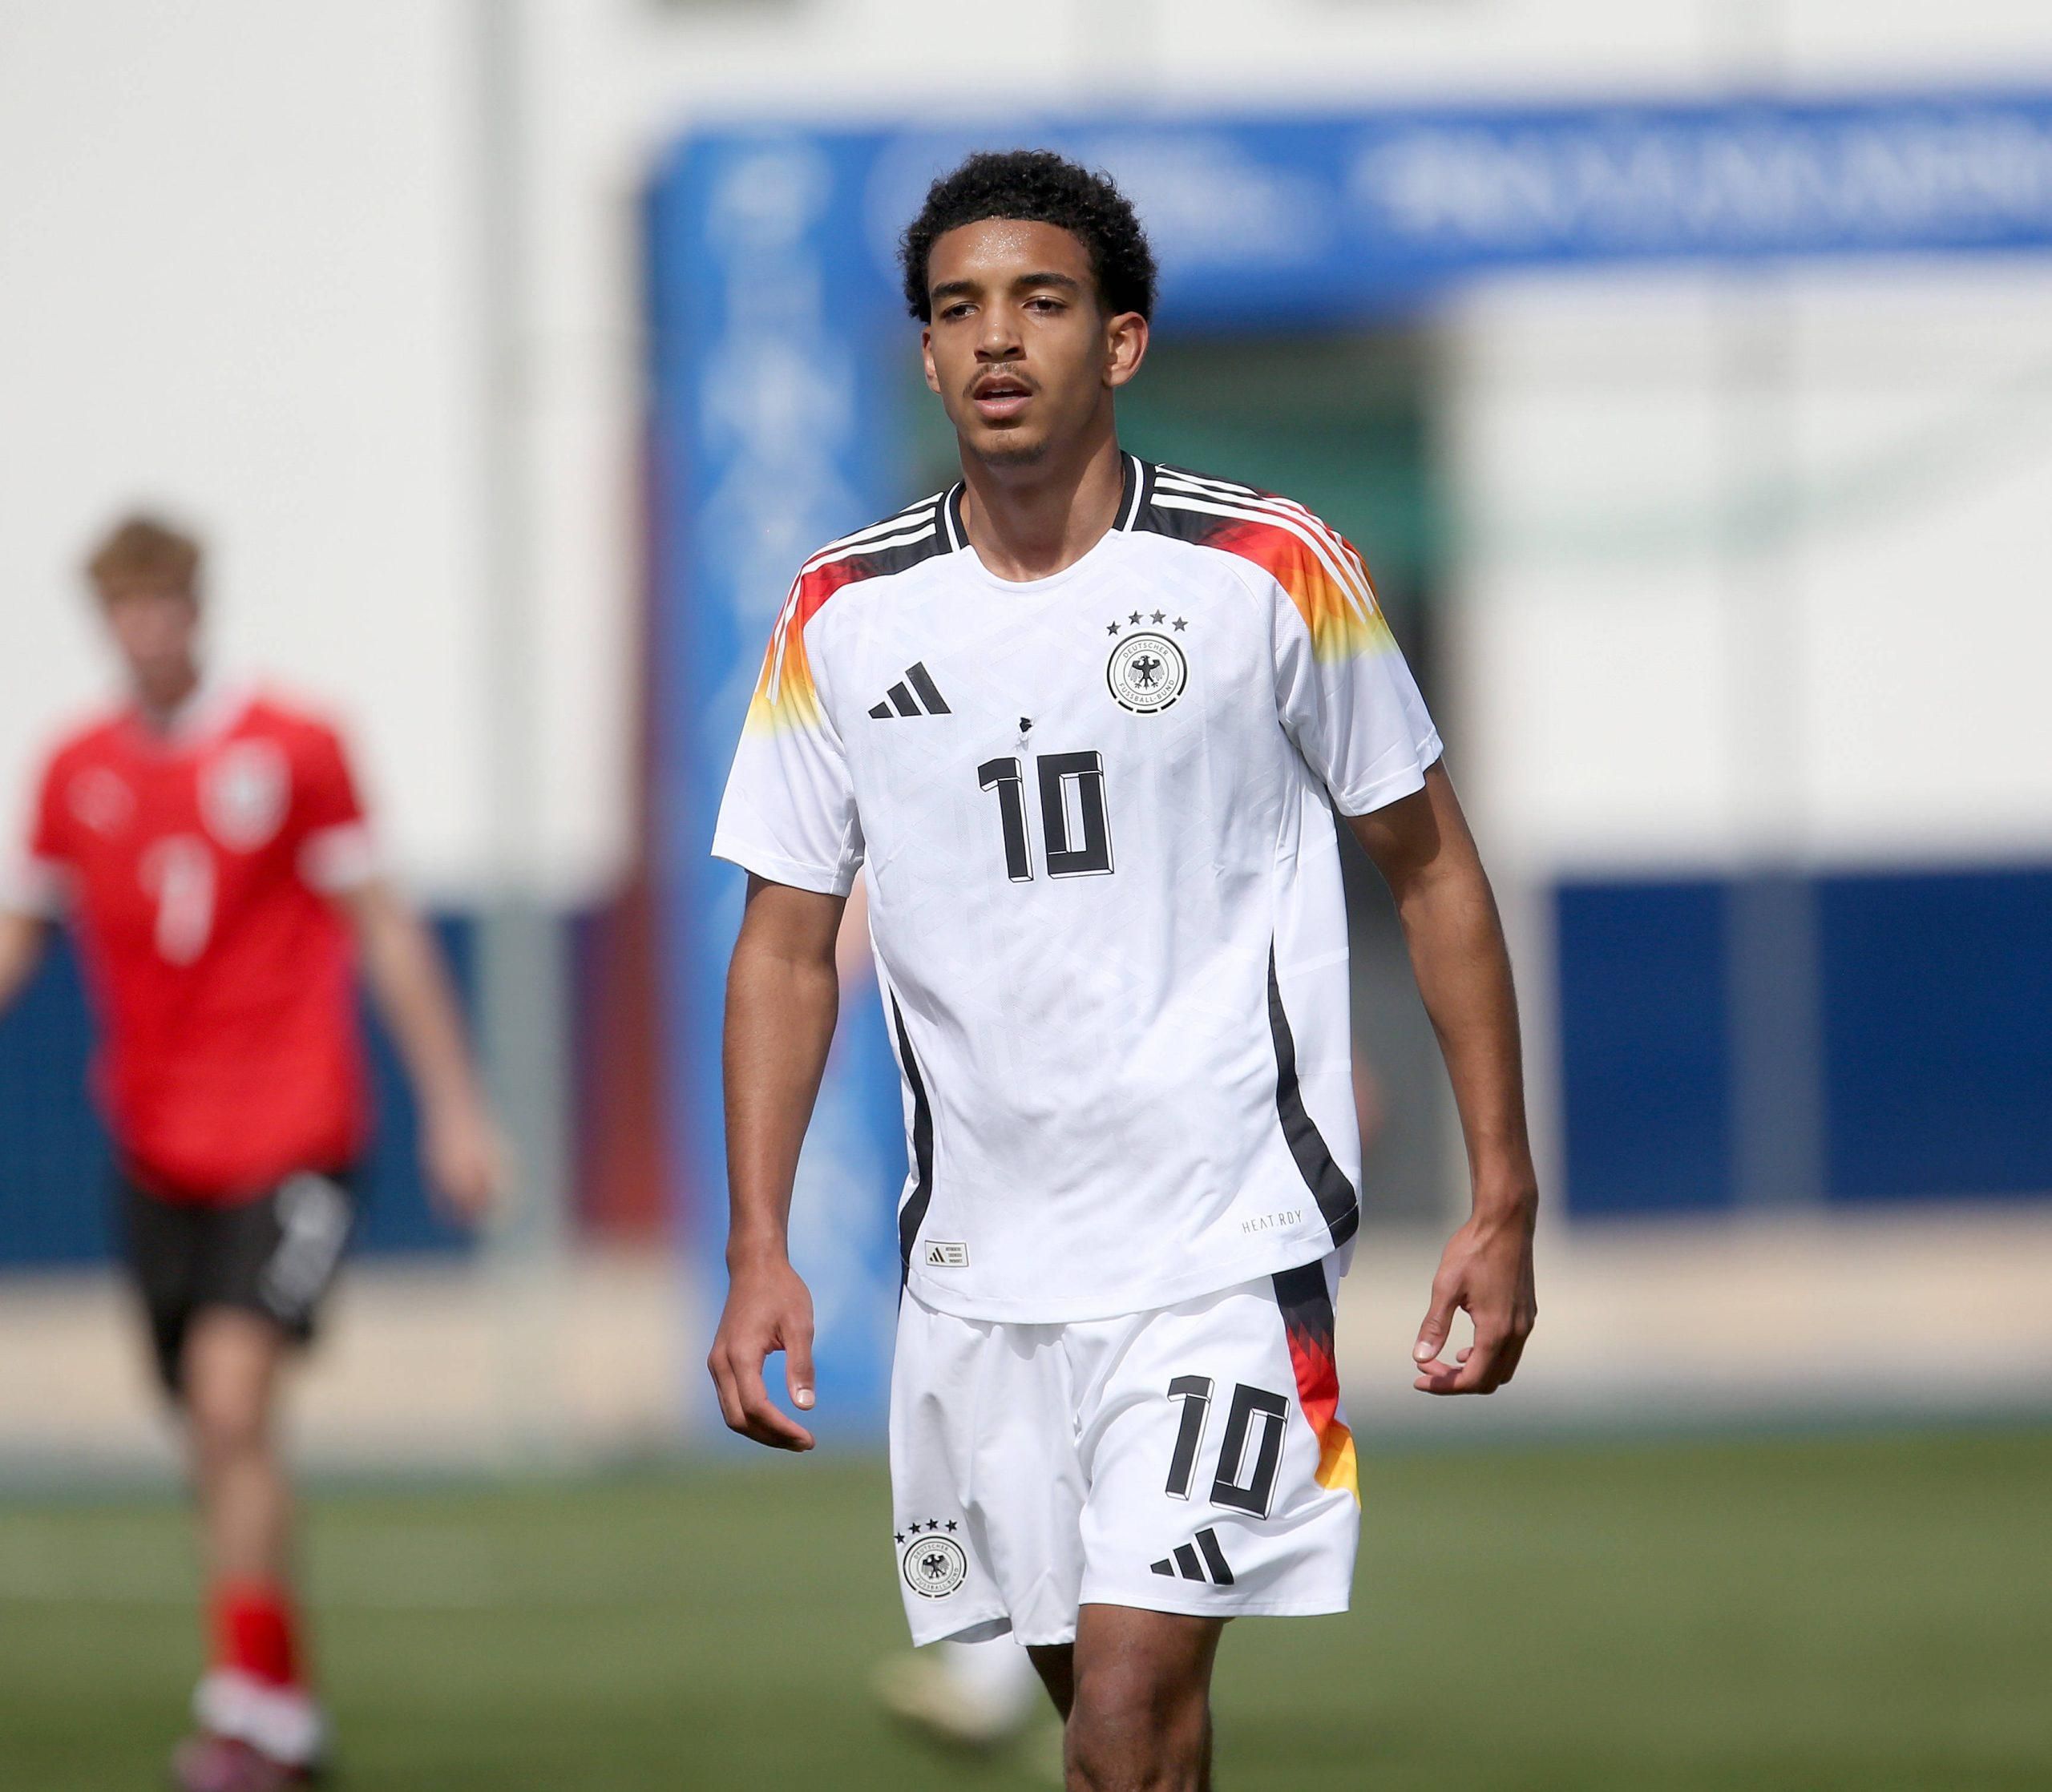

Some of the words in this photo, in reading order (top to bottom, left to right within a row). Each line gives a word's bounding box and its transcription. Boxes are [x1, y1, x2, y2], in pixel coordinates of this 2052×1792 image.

[1123, 642, 1169, 658] DEUTSCHER
[1119, 680, 1174, 703] FUSSBALL-BUND
[977, 750, 1115, 883] 10
[1165, 1374, 1291, 1520] 10
[914, 1544, 949, 1560] DEUTSCHER
[916, 1568, 959, 1590] FUSSBALL-BUND
